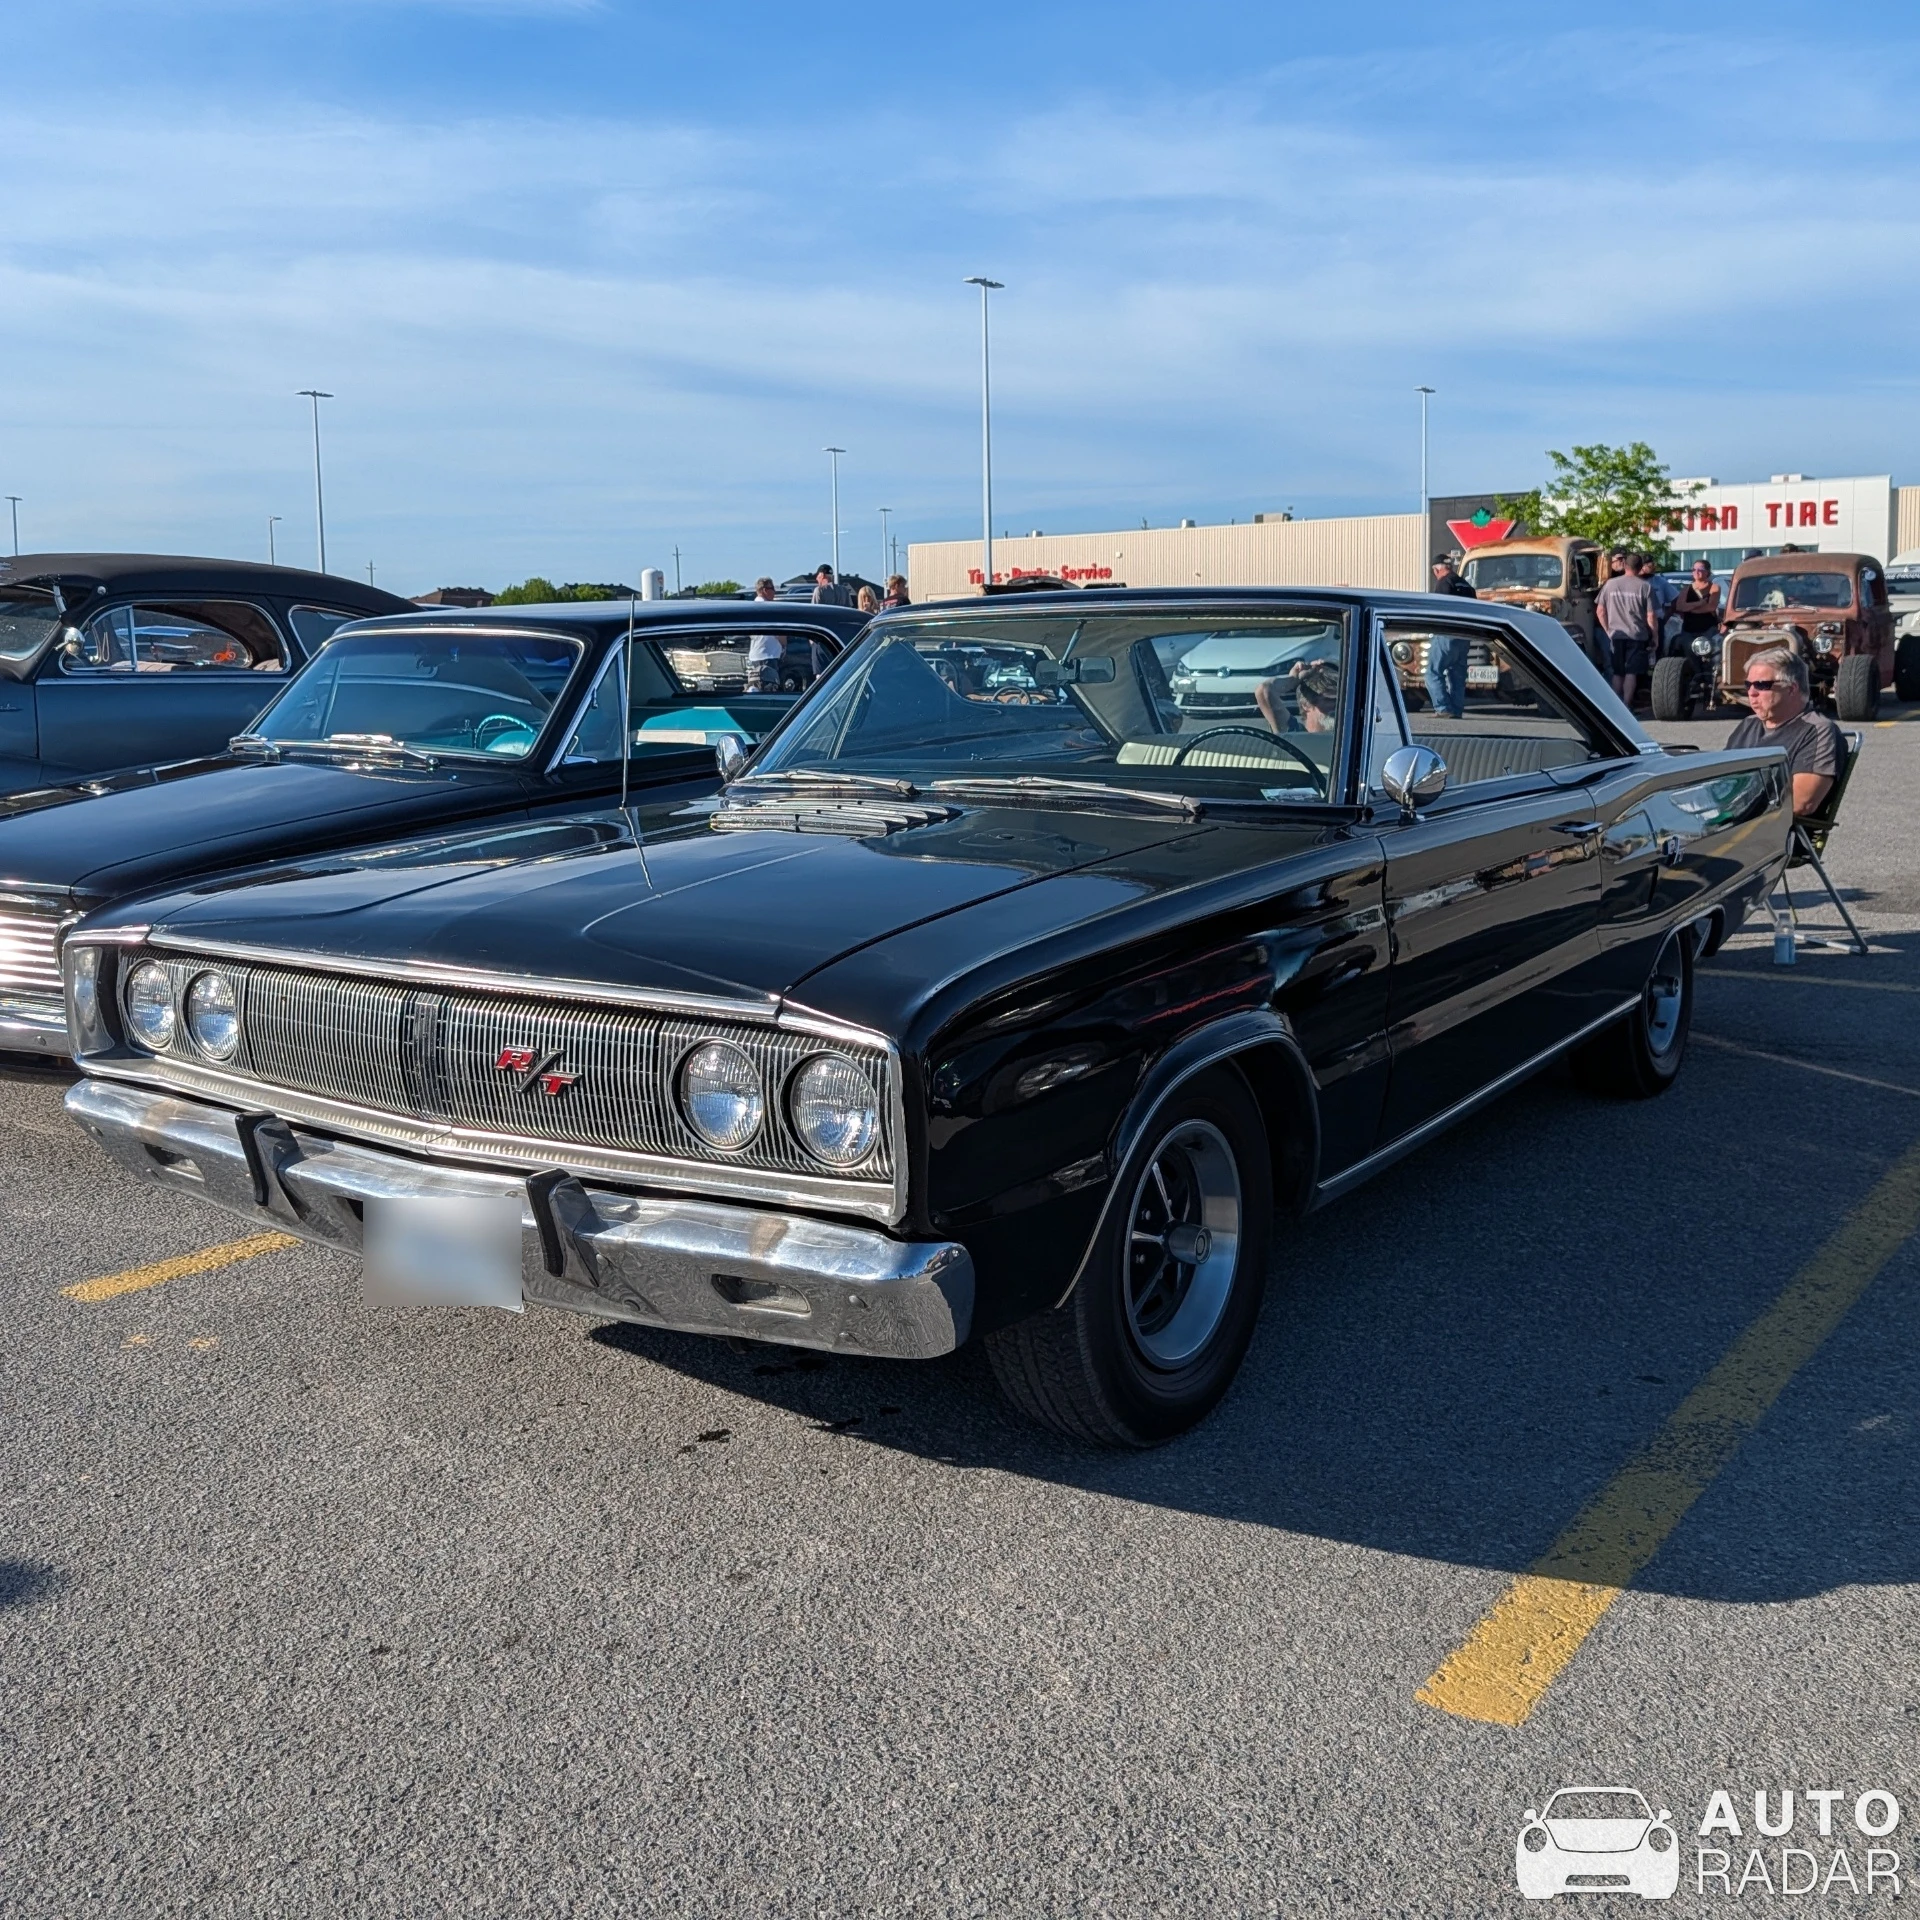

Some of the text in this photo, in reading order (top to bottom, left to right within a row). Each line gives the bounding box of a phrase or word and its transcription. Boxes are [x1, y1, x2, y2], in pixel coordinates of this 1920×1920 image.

[1766, 500, 1839, 528] TIRE
[1061, 563, 1112, 580] Service
[495, 1044, 583, 1096] R/T
